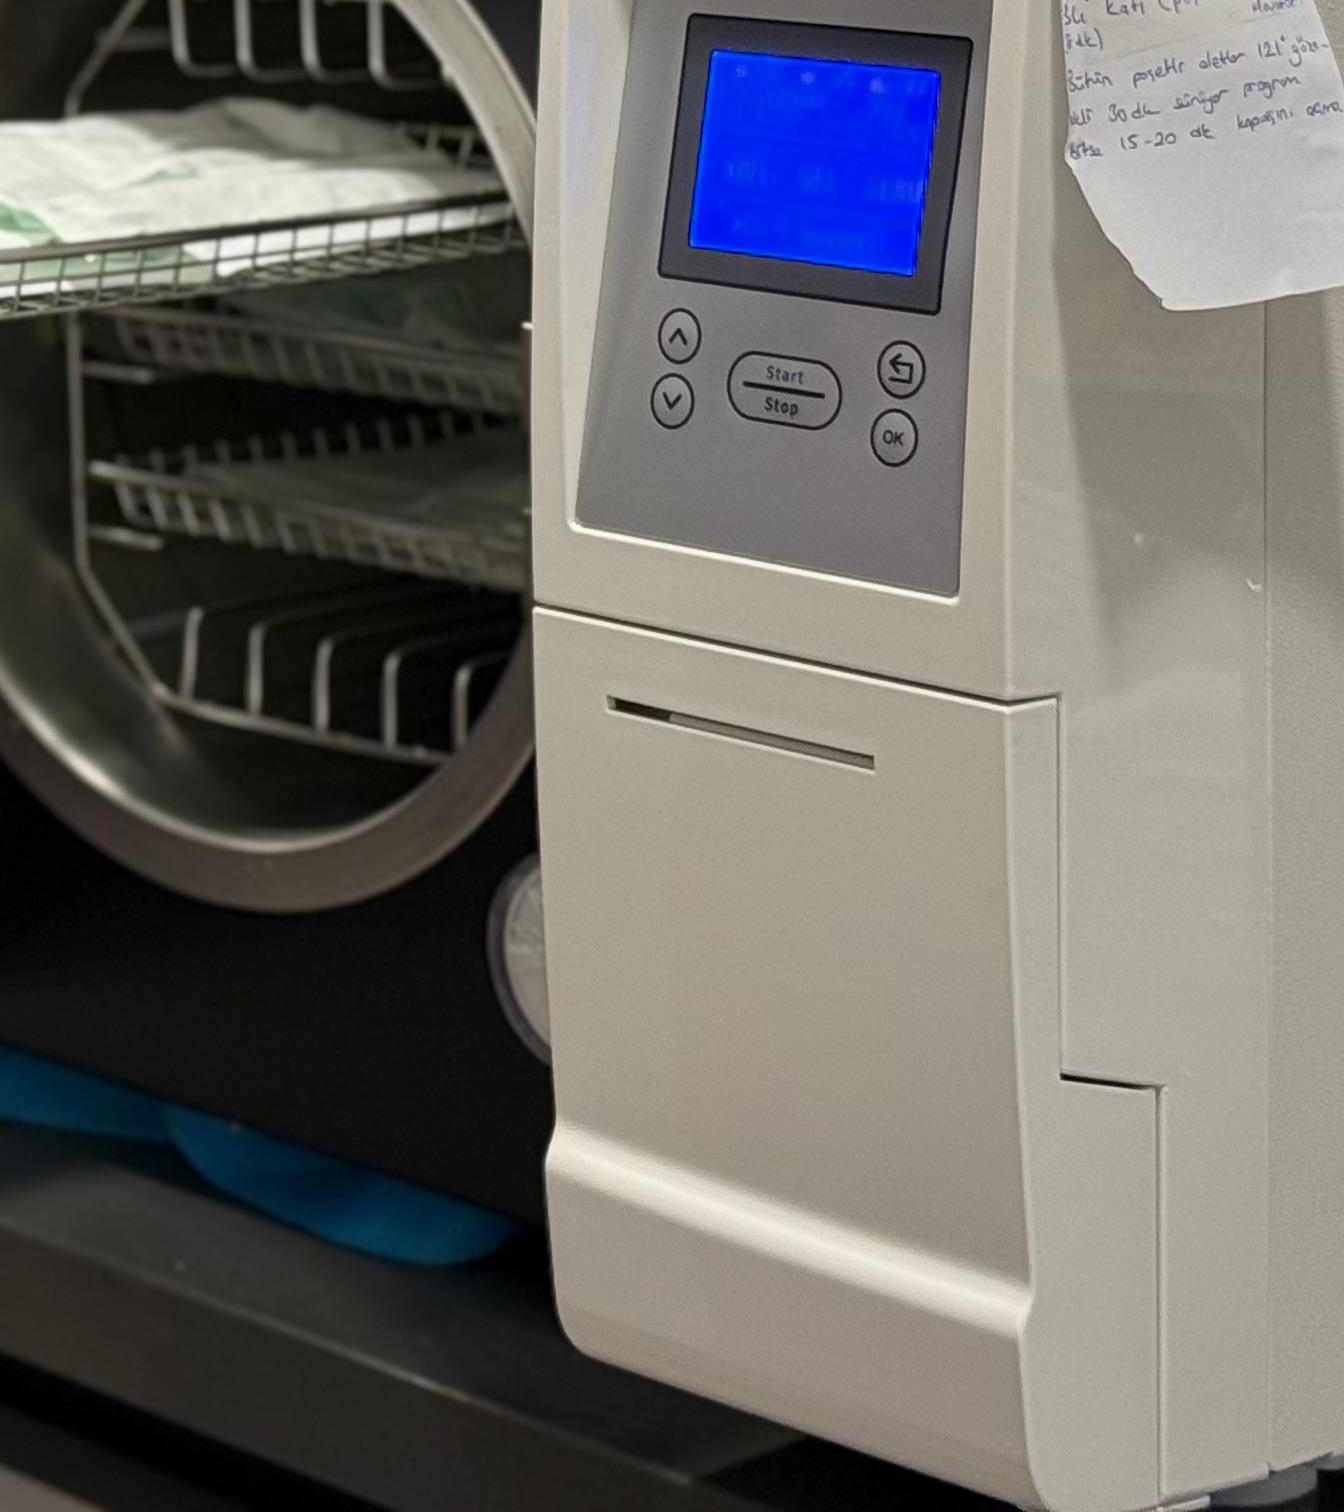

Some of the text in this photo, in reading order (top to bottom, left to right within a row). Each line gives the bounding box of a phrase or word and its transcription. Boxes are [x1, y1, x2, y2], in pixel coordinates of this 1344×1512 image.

[766, 364, 806, 386] Start
[764, 396, 800, 419] Stop
[882, 429, 905, 447] OK
